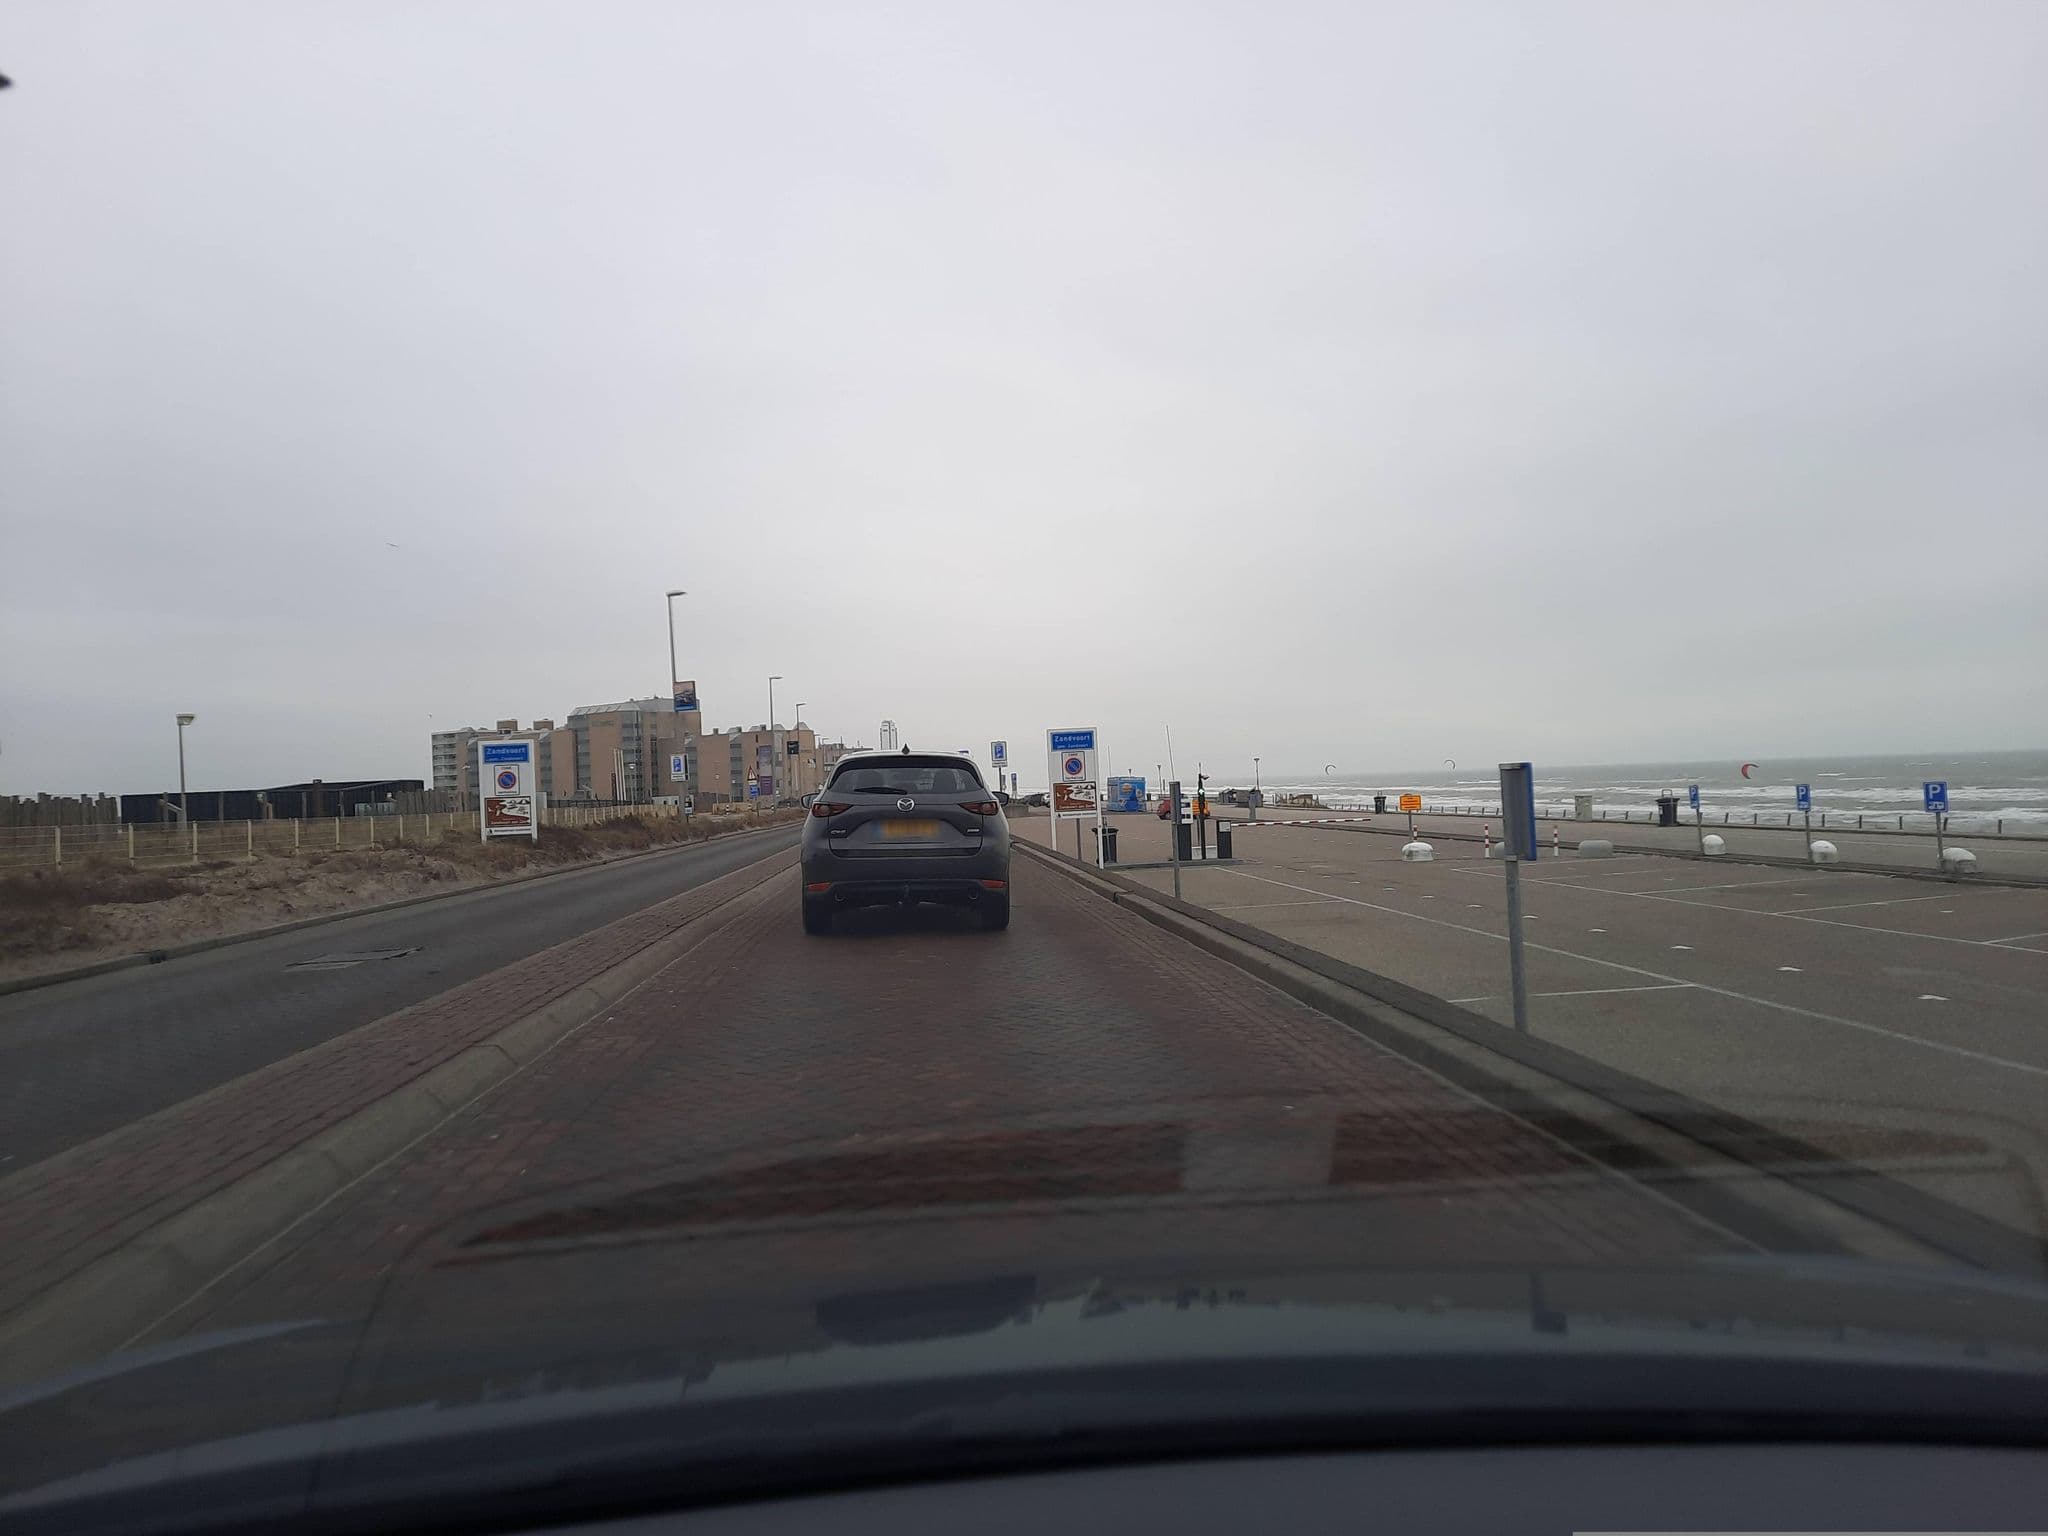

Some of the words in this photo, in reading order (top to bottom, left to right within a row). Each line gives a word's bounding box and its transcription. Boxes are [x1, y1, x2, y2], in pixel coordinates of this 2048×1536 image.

[486, 747, 526, 755] Zandvoort
[1798, 786, 1807, 800] P
[1929, 784, 1941, 799] P
